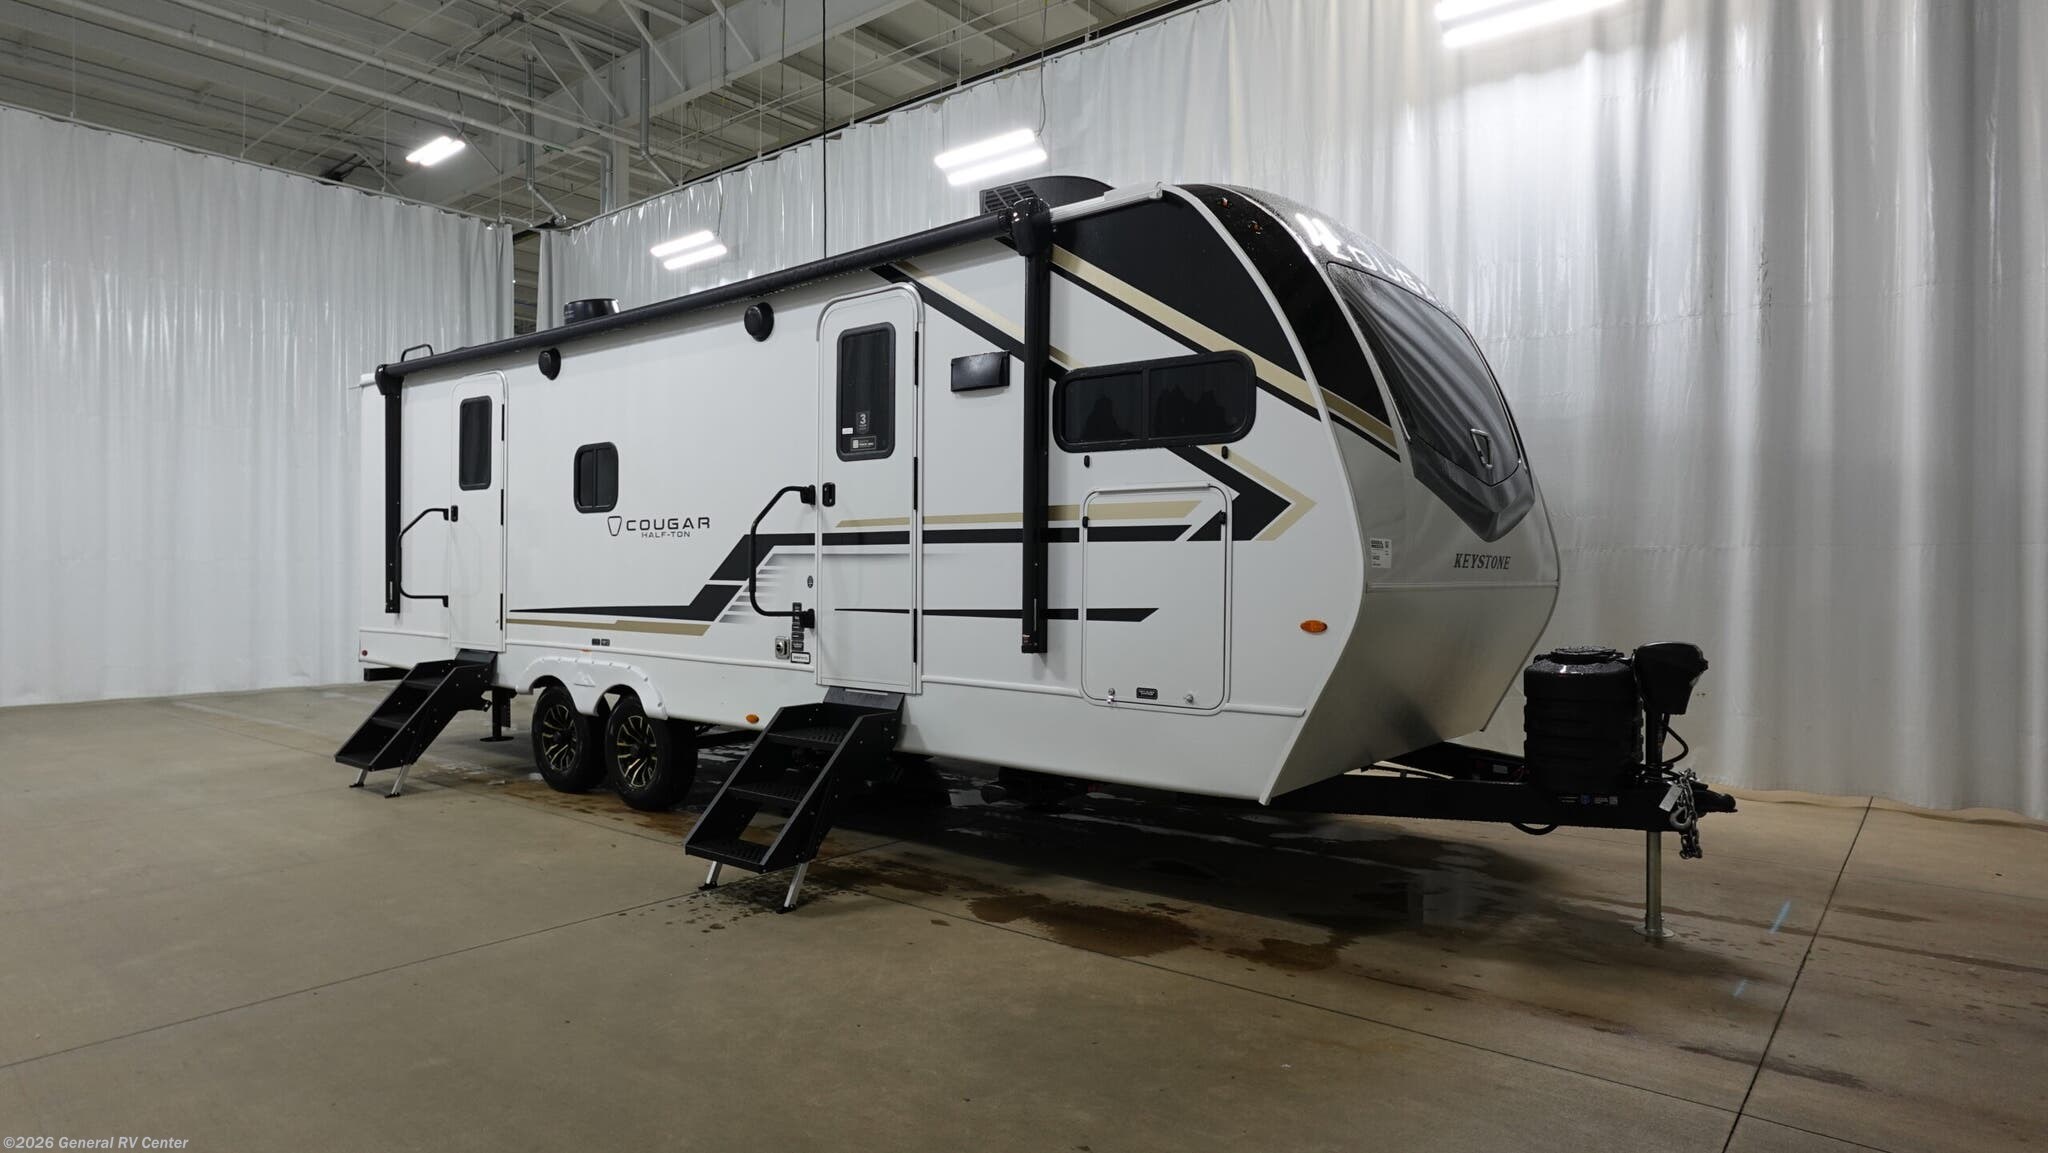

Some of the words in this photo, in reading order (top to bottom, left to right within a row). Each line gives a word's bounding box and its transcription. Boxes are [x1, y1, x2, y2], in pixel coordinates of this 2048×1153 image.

[860, 413, 867, 424] 3
[626, 517, 710, 531] COUGAR
[641, 531, 691, 539] HALF-TON
[1453, 553, 1512, 570] KEYSTONE
